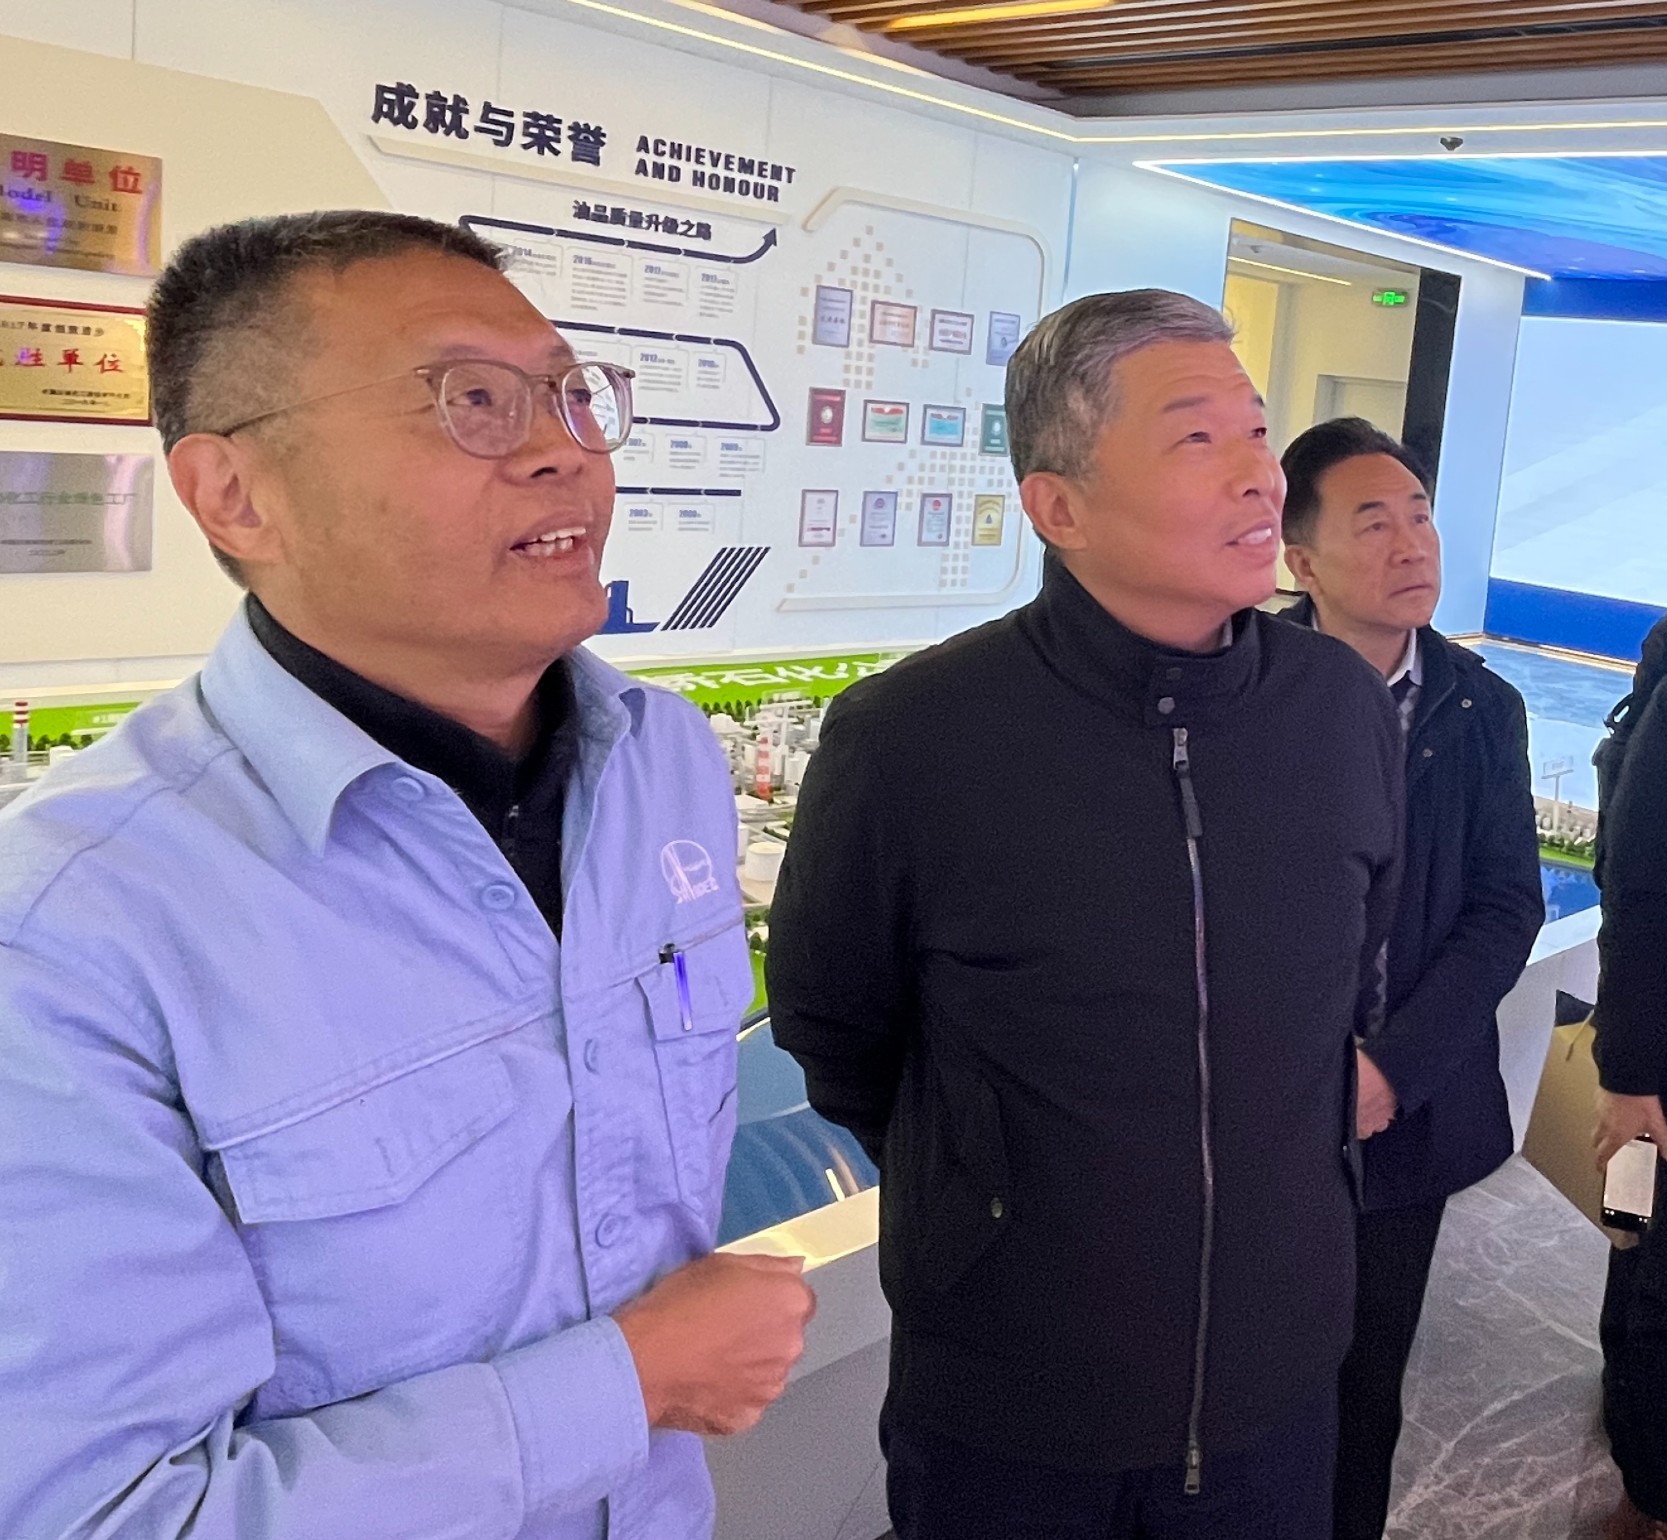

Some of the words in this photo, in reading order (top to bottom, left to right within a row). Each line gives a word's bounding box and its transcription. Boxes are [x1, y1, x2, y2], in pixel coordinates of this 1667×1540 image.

[371, 82, 608, 167] 成就与荣誉
[634, 158, 683, 184] AND
[691, 169, 780, 203] HONOUR
[635, 135, 797, 185] ACHIEVEMENT
[0, 184, 52, 203] odel
[572, 199, 712, 242] 油品质量升级之路
